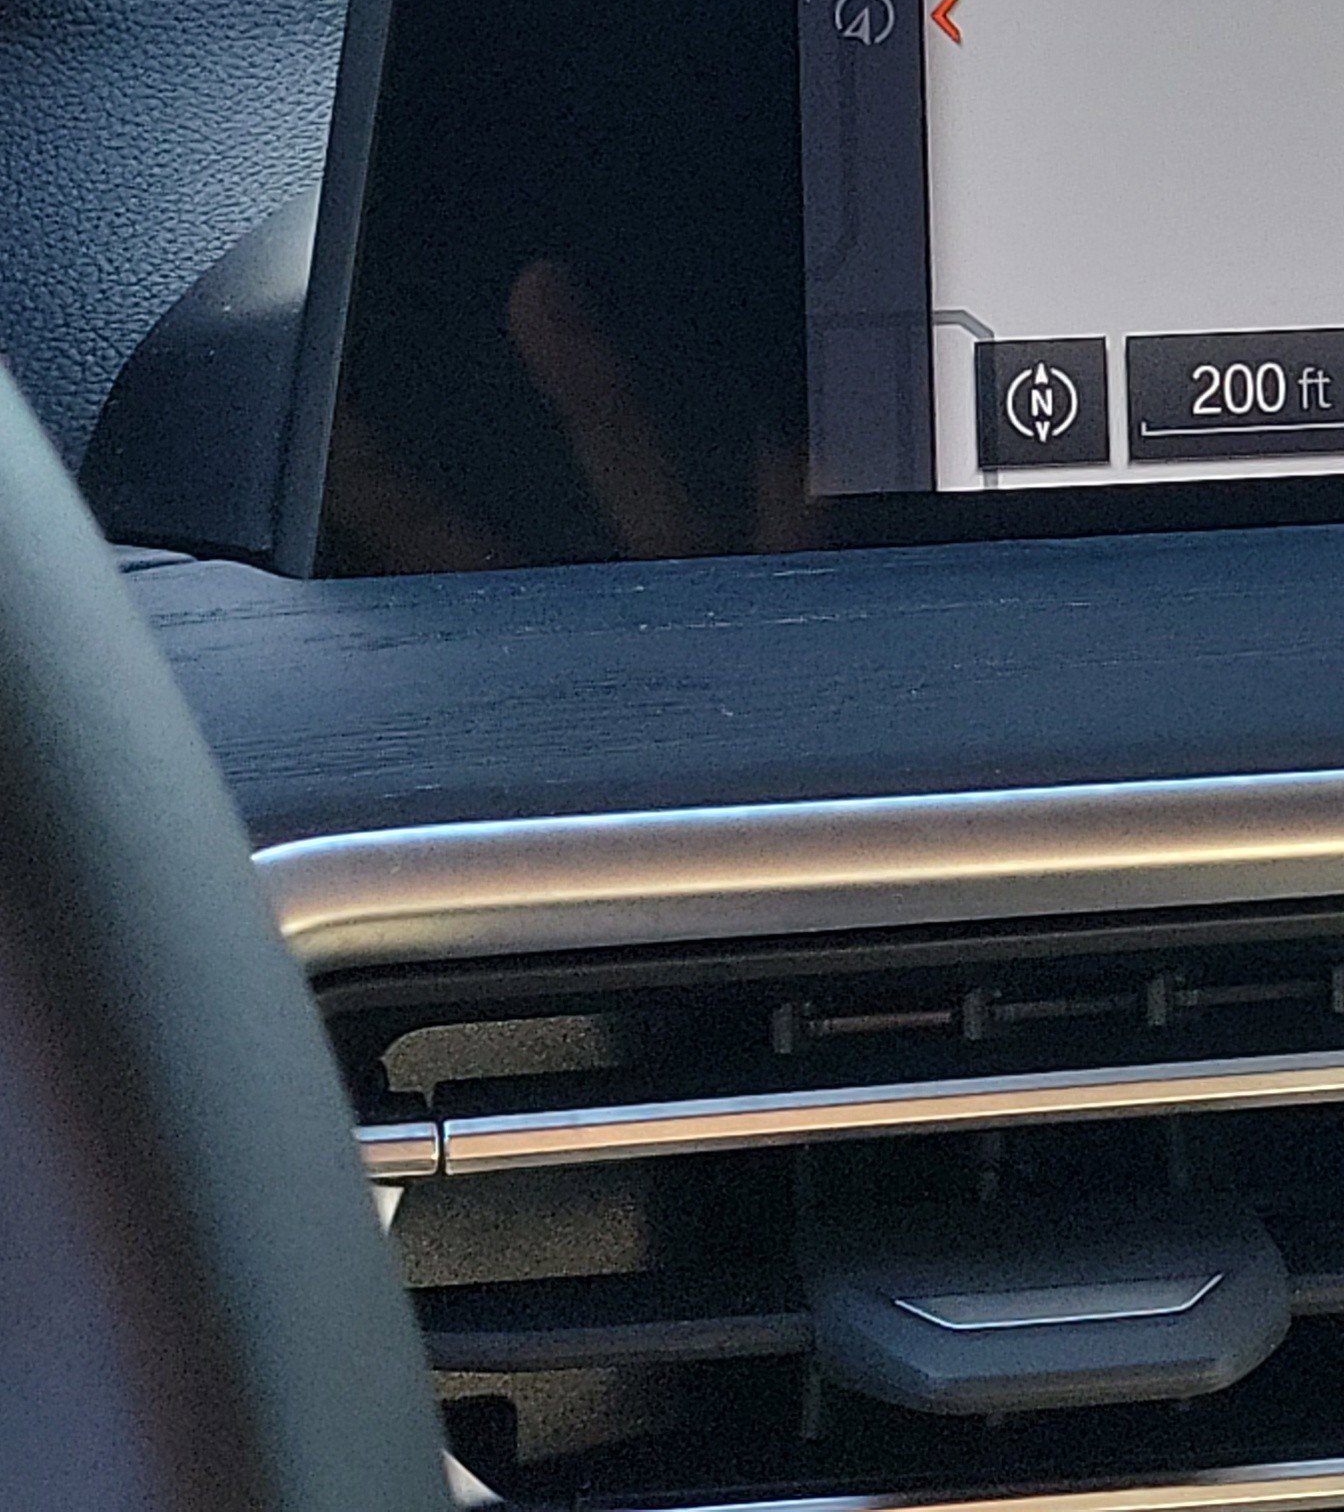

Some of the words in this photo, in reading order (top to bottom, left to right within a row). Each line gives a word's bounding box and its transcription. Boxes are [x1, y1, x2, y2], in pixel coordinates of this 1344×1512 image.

[1031, 388, 1055, 417] N
[1191, 362, 1287, 415] 200
[1296, 368, 1332, 410] ft
